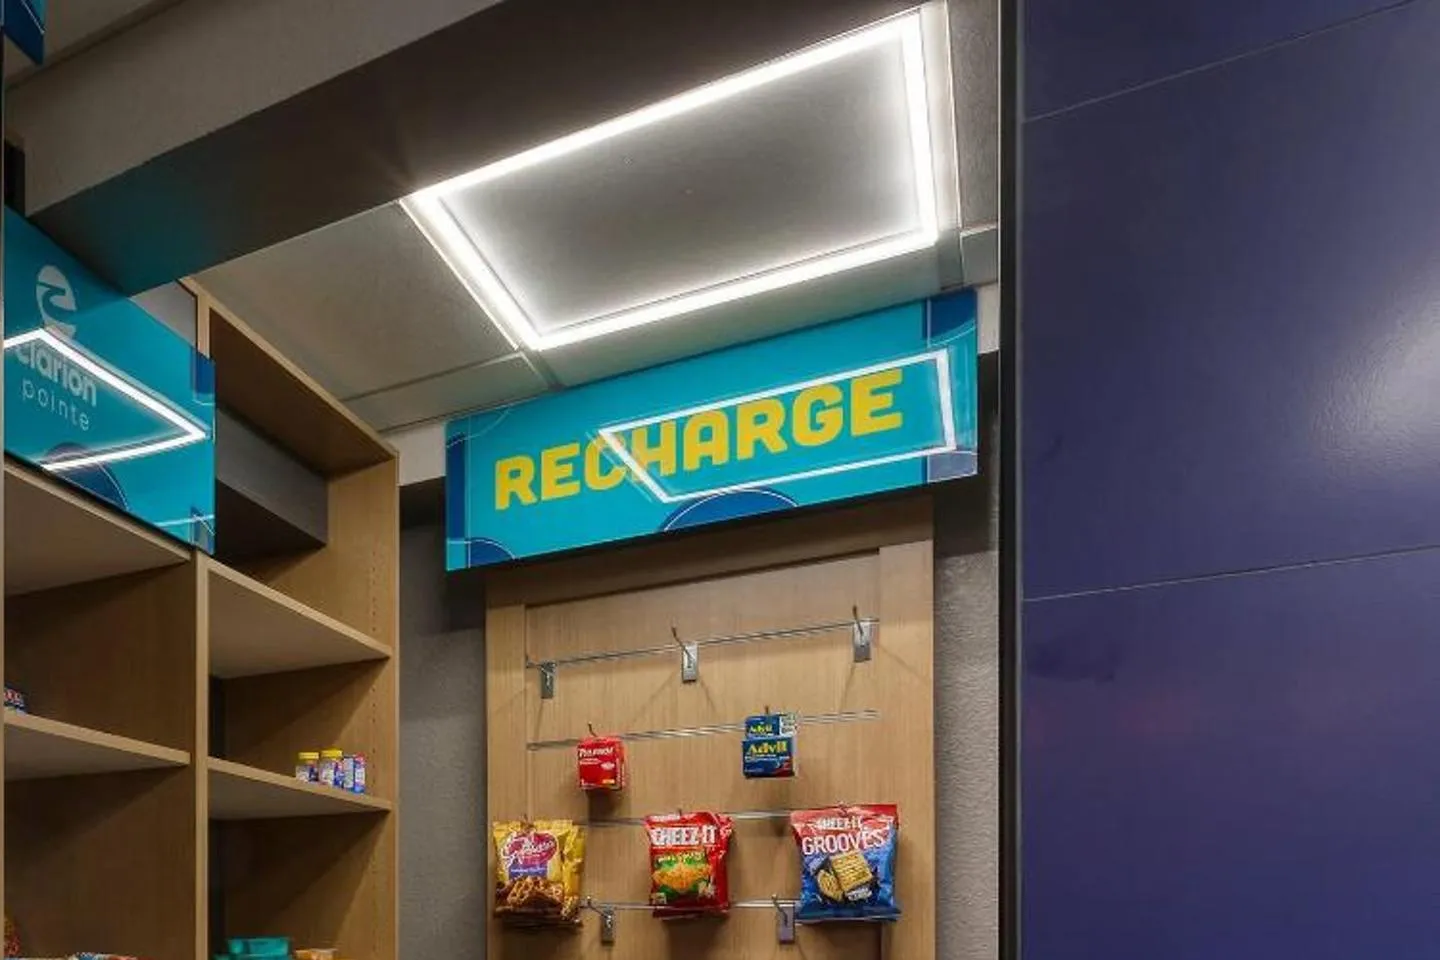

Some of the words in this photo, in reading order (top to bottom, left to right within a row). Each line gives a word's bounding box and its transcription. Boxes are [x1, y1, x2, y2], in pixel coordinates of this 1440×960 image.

[22, 379, 90, 431] pointe
[494, 368, 903, 511] RECHARGE
[749, 740, 787, 754] Advil
[801, 828, 885, 856] GROOVES
